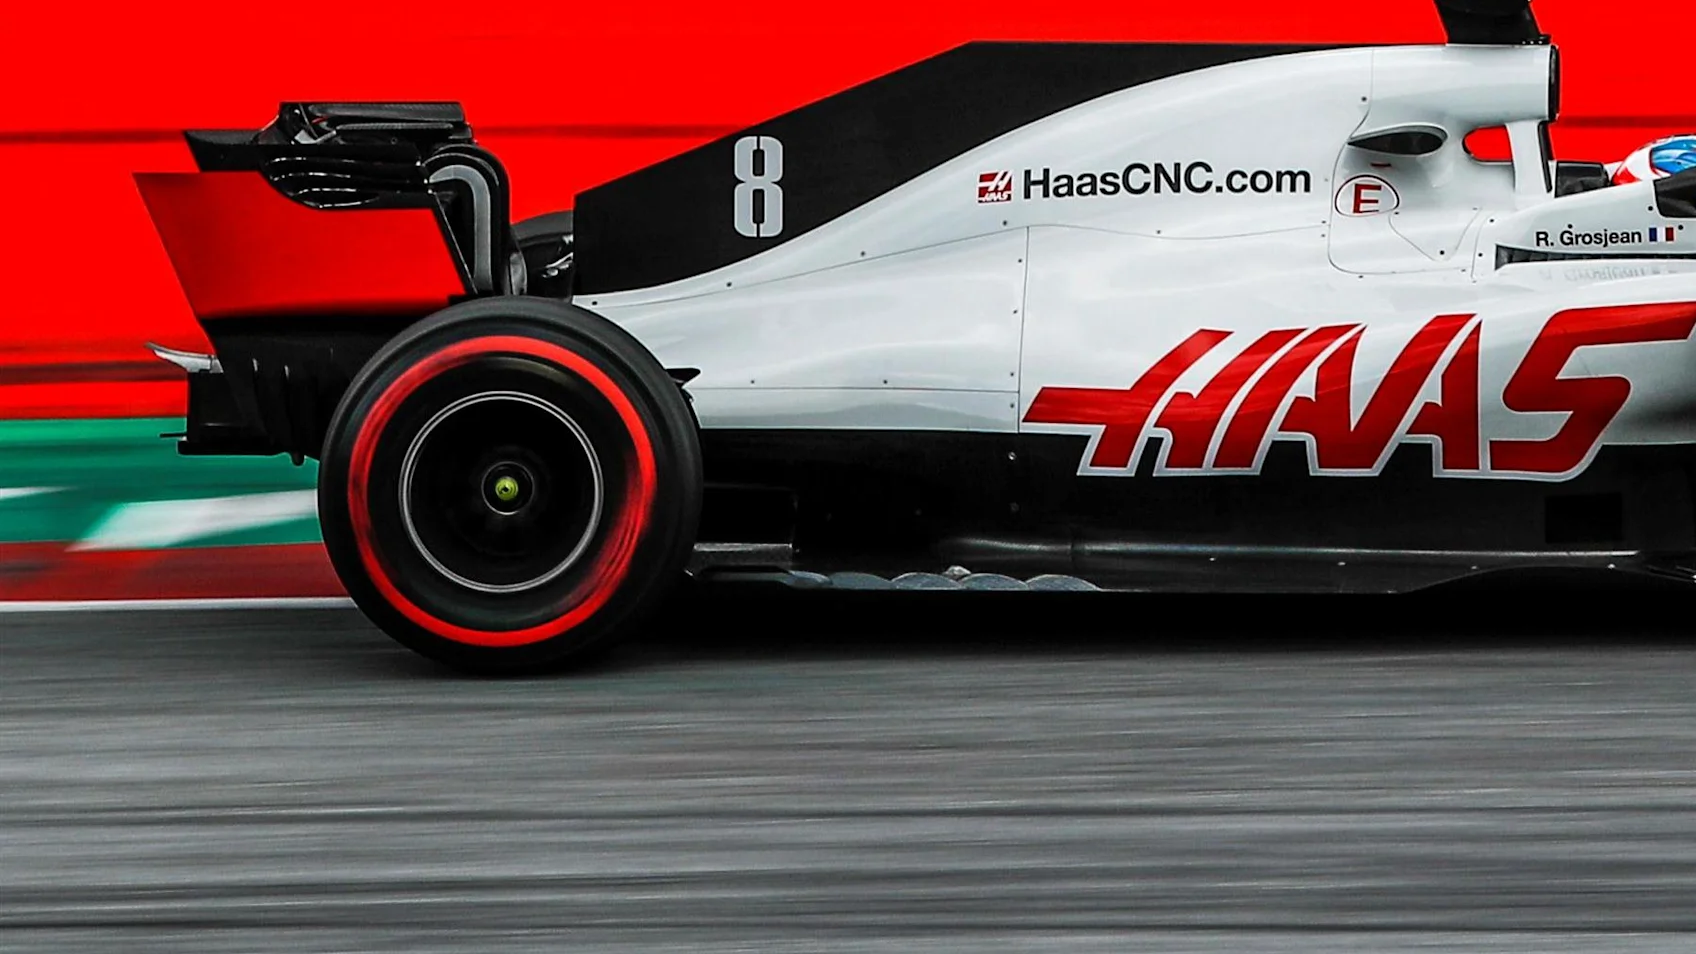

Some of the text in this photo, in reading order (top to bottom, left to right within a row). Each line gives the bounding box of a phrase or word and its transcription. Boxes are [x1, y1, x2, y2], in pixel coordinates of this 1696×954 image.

[733, 135, 783, 238] 8
[1023, 161, 1311, 199] HaasCNC.com
[1353, 183, 1382, 214] E
[1535, 229, 1642, 248] R. Grosjean
